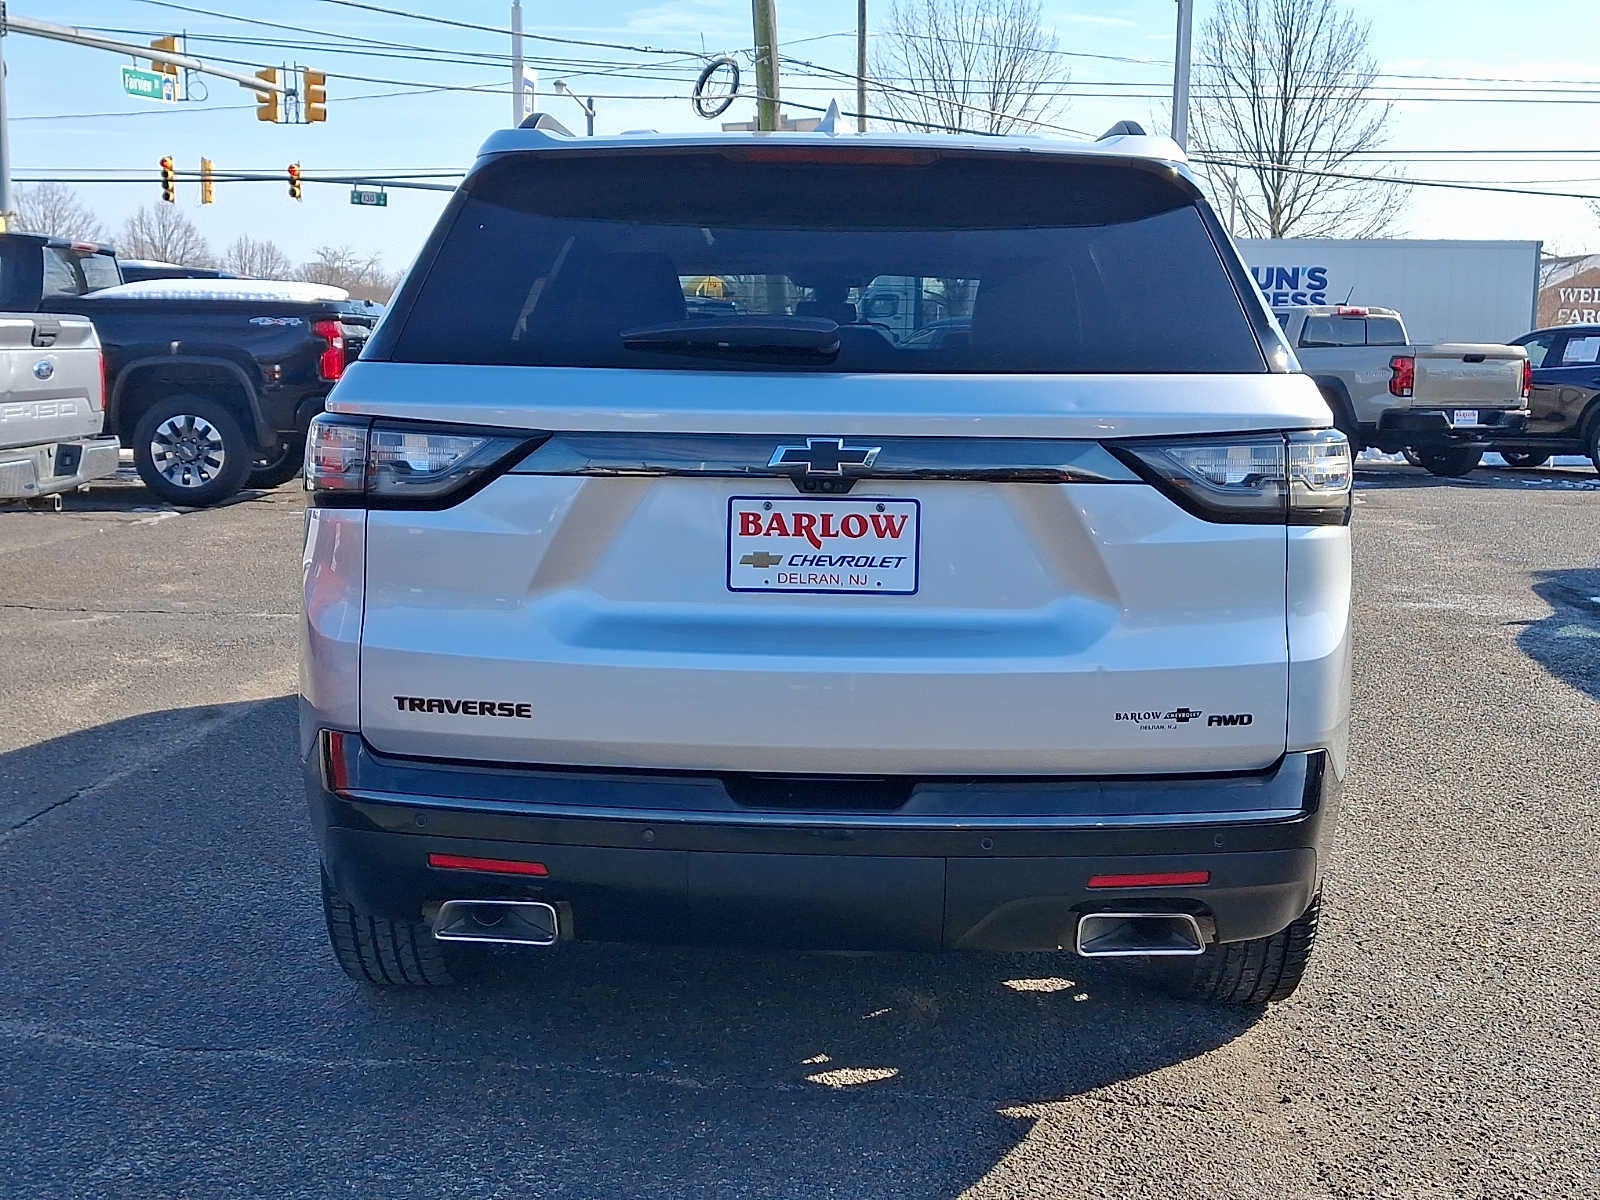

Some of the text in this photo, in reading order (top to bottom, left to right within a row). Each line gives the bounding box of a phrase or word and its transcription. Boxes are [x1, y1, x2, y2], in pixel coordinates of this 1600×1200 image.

[124, 72, 152, 93] Fairview
[738, 512, 909, 550] BARLOW
[787, 554, 908, 569] CHEVROLET
[777, 572, 868, 586] DELRAN, NJ
[393, 695, 533, 719] TRAVERSE
[1114, 711, 1162, 724] BARLOW
[1207, 713, 1253, 727] AWD
